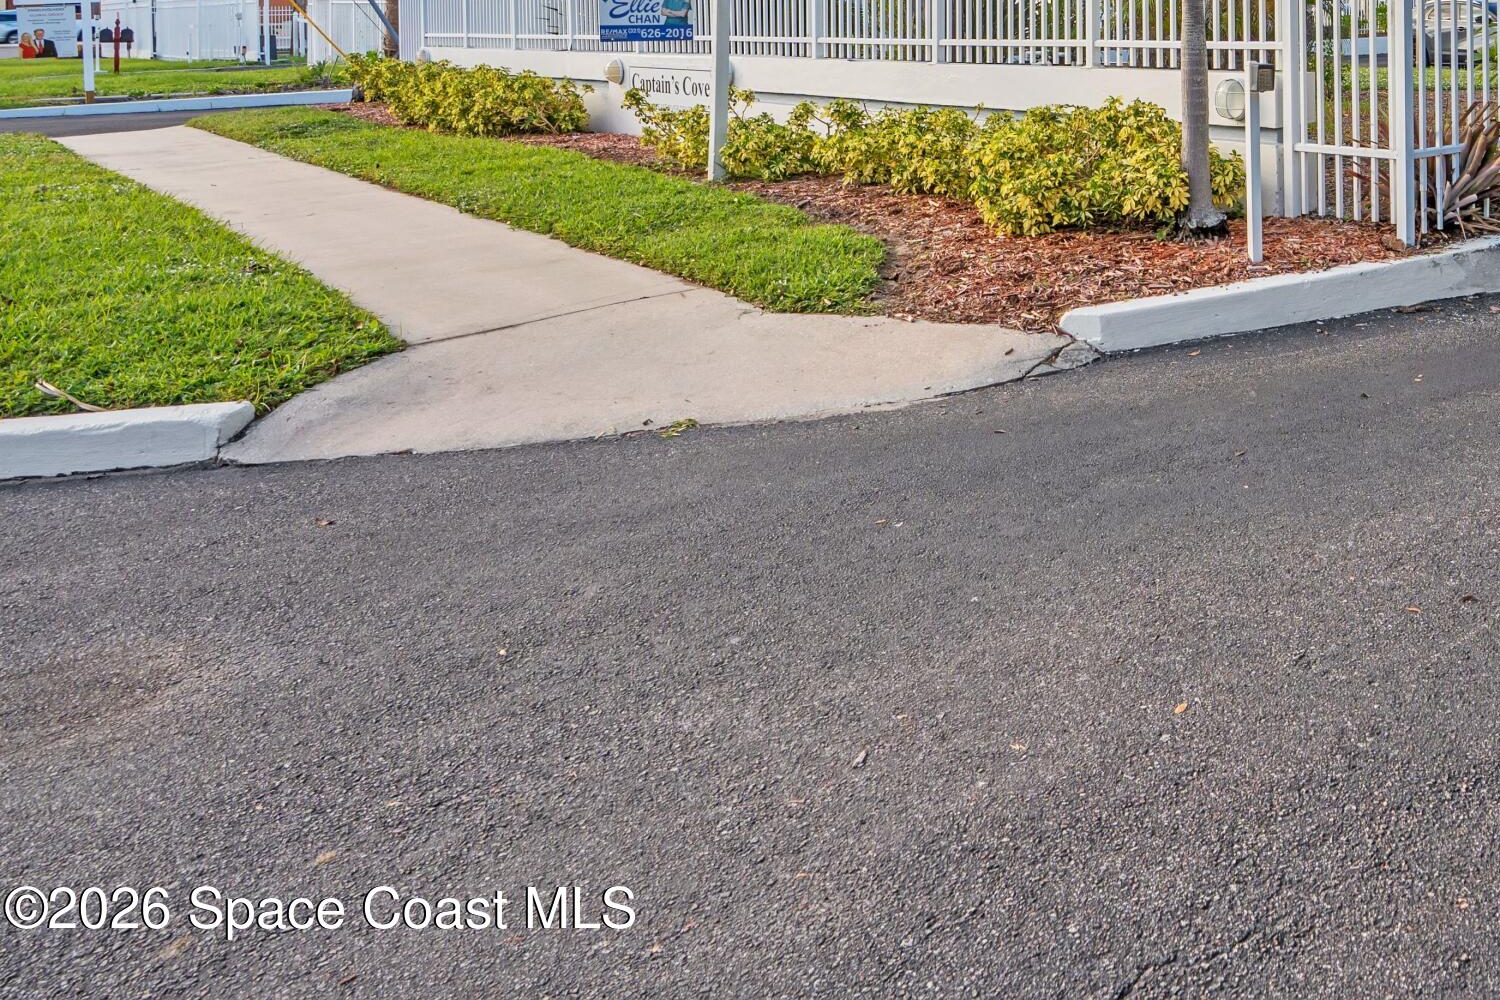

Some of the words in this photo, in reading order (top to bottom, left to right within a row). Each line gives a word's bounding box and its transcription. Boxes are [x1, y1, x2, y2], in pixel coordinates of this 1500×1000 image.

[628, 14, 660, 24] CHAN
[641, 28, 693, 39] 626-2016
[632, 73, 680, 97] Captain's
[683, 76, 710, 97] Cove
